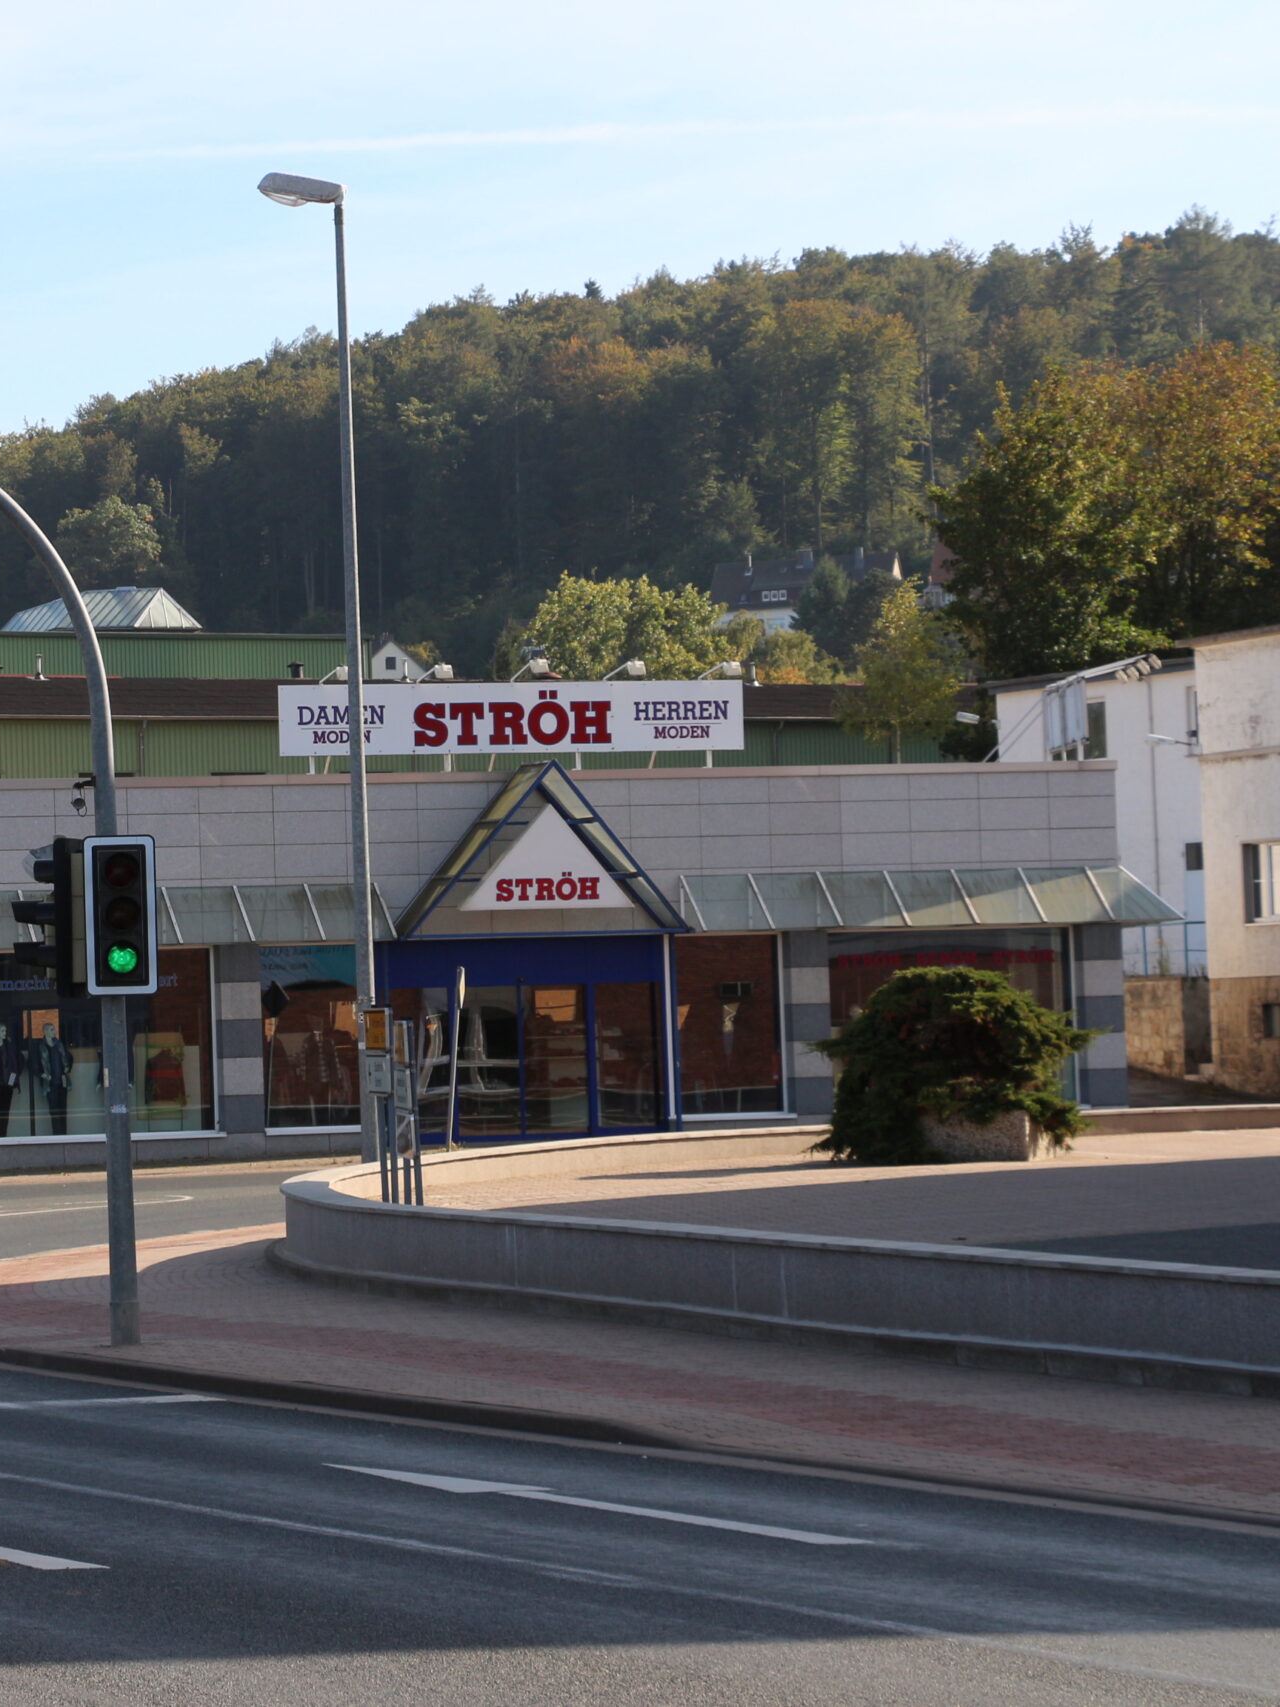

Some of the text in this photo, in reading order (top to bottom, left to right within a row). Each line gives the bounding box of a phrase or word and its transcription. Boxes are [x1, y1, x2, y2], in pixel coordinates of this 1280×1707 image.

[413, 690, 612, 747] STRÖH
[633, 700, 729, 721] HERREN
[313, 730, 372, 744] MODN
[653, 725, 711, 740] MODEN
[496, 871, 600, 902] STRÖH
